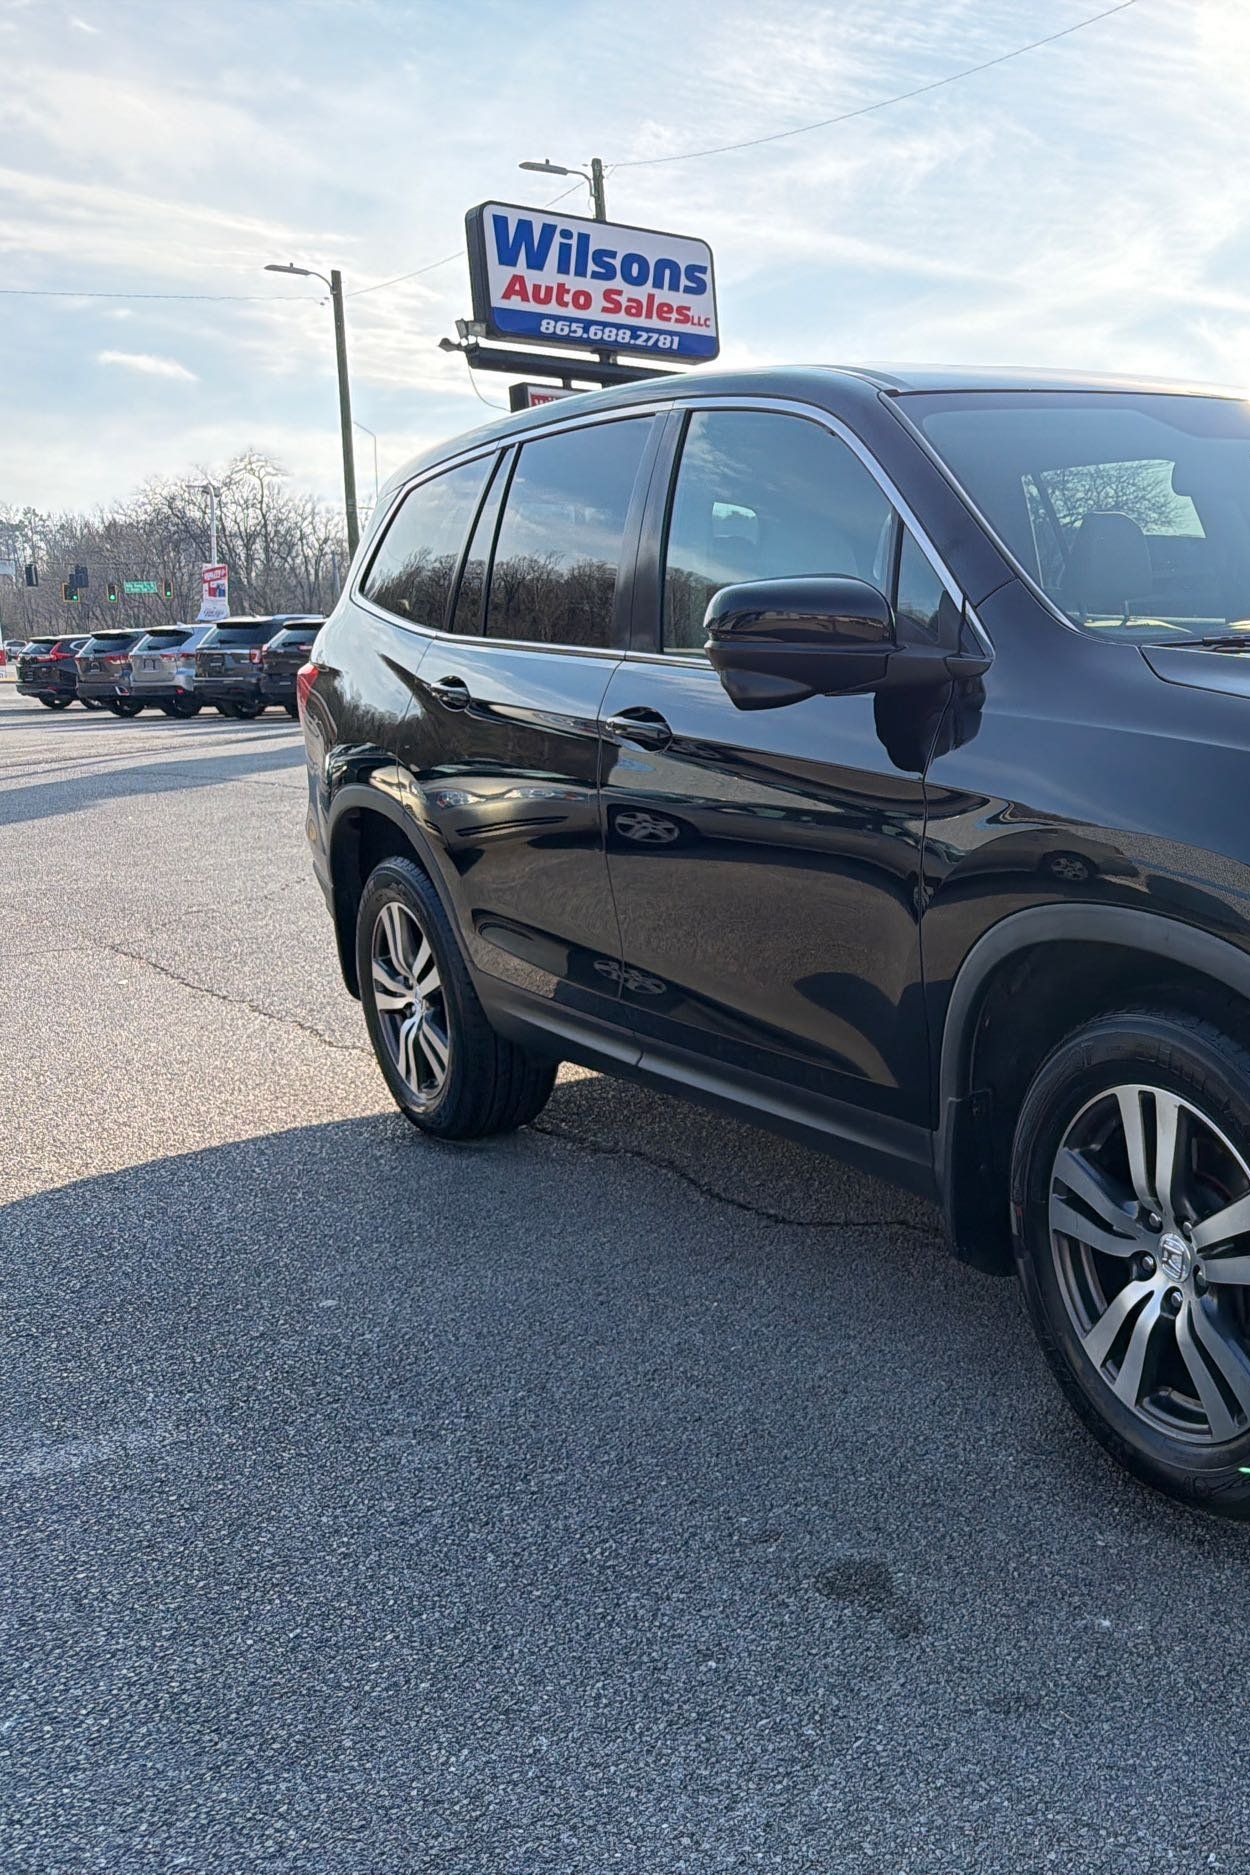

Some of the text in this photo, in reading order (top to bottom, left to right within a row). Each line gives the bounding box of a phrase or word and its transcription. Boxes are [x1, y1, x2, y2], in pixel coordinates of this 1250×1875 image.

[492, 214, 708, 295] Wilsons
[501, 274, 710, 328] Auto Sales LLC
[540, 319, 680, 350] 865.688.2781
